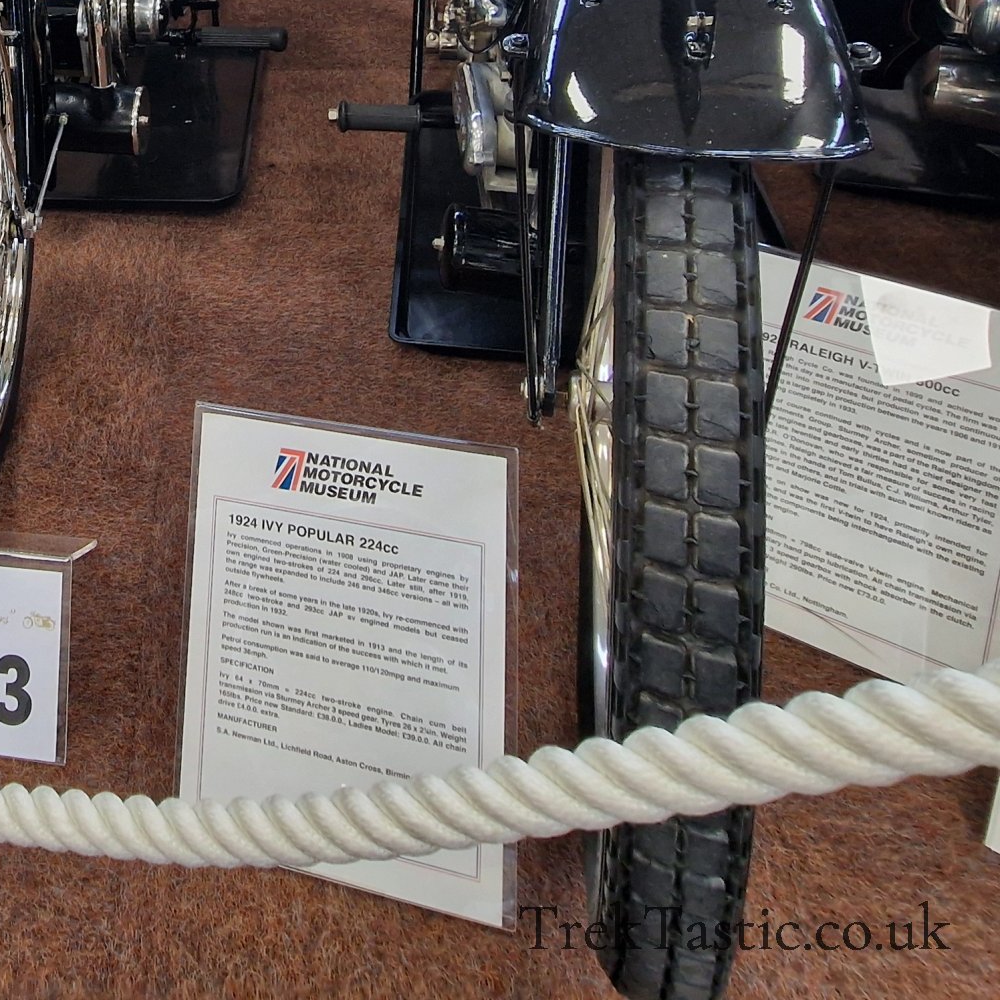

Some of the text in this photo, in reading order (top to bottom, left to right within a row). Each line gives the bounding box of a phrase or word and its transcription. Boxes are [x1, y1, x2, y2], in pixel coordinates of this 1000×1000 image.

[789, 340, 854, 366] RALEIGH
[303, 466, 423, 497] MOTORCYCLE
[306, 452, 394, 477] NATIONAL
[300, 480, 377, 504] MUSEUM
[781, 459, 796, 467] and
[823, 473, 839, 482] and
[848, 481, 868, 493] trials
[869, 489, 886, 499] with
[887, 495, 907, 505] such
[908, 502, 925, 512] well
[926, 507, 954, 522] known
[955, 518, 980, 531] riders
[229, 513, 399, 555] 1924 IVY POPULAR 224cc
[766, 492, 985, 576] the components being interchangeable with the existing
[226, 530, 237, 540] Ivy
[240, 534, 282, 547] commenced
[284, 543, 322, 555] operations
[357, 556, 378, 567] using
[381, 560, 422, 575] proprietary
[425, 569, 455, 580] engines
[459, 574, 469, 584] by
[372, 568, 386, 576] and
[407, 573, 427, 583] Later
[428, 579, 450, 588] came
[451, 582, 469, 592] their
[776, 549, 799, 562] speed
[800, 559, 832, 574] gearbox
[834, 572, 851, 582] with
[853, 579, 877, 592] shock
[879, 589, 916, 607] absorber
[929, 607, 944, 618] the
[783, 542, 802, 554] hand
[803, 551, 825, 563] pump
[871, 576, 883, 585] All
[883, 582, 906, 594] chain
[908, 590, 962, 615] transmission
[963, 611, 977, 621] via
[222, 610, 236, 619] The
[237, 615, 259, 625] model
[261, 619, 285, 630] shown
[287, 626, 302, 634] was
[304, 628, 319, 638] first
[321, 632, 355, 645] marketed
[357, 639, 365, 647] in
[388, 647, 402, 655] and
[405, 649, 417, 658] the
[420, 652, 444, 663] length
[458, 660, 468, 669] its
[220, 656, 274, 675] SPECIFICATION
[217, 711, 278, 733] MANUFACTURER
[231, 730, 262, 744] Newman
[280, 741, 312, 756] Lichfield
[335, 755, 358, 768] Aston
[385, 768, 410, 780] Birmin
